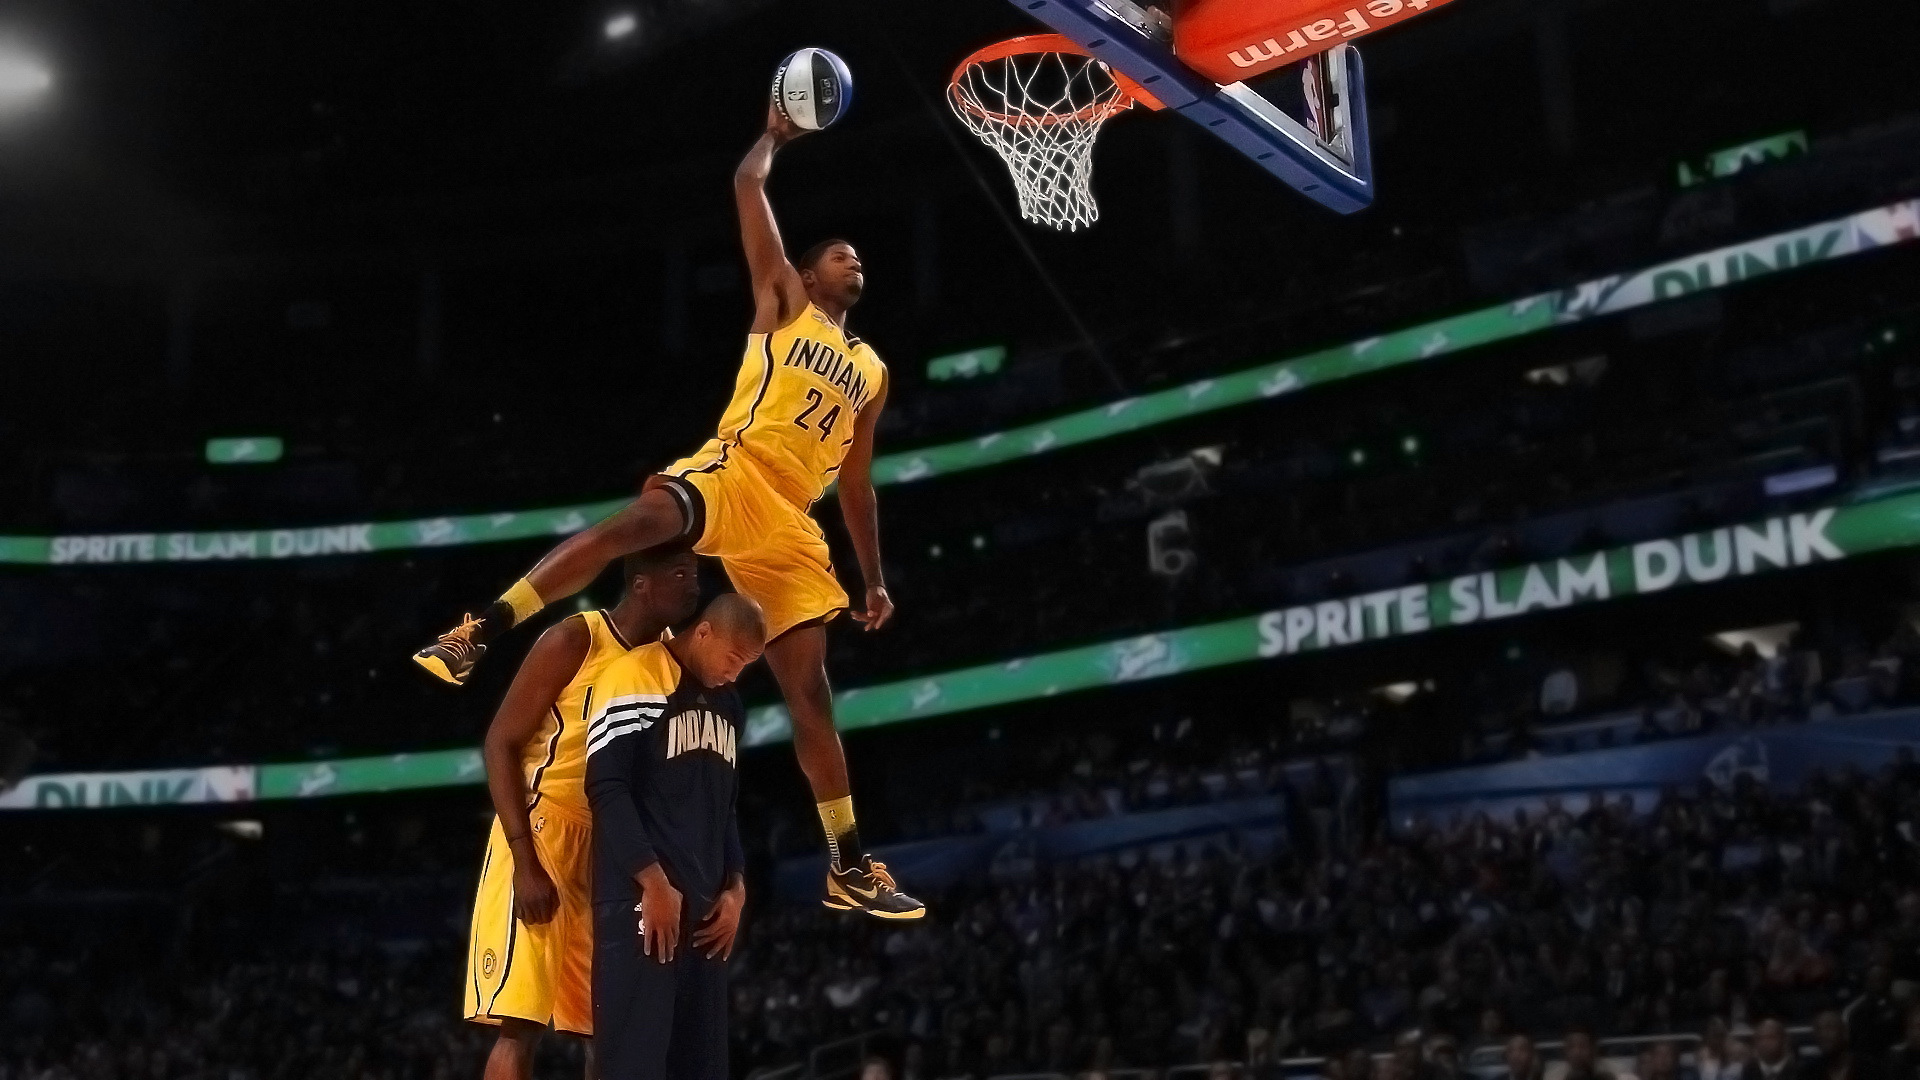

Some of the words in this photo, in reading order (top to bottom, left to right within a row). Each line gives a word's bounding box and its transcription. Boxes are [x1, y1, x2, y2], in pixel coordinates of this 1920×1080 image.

[793, 387, 842, 443] 24
[51, 536, 154, 563] SPRITE
[166, 533, 256, 559] SLAM
[270, 523, 372, 557] DUNK
[1257, 584, 1431, 657] SPRITE
[1448, 551, 1610, 624] SLAM
[1633, 508, 1846, 593] DUNK
[666, 709, 736, 770] INDIANA
